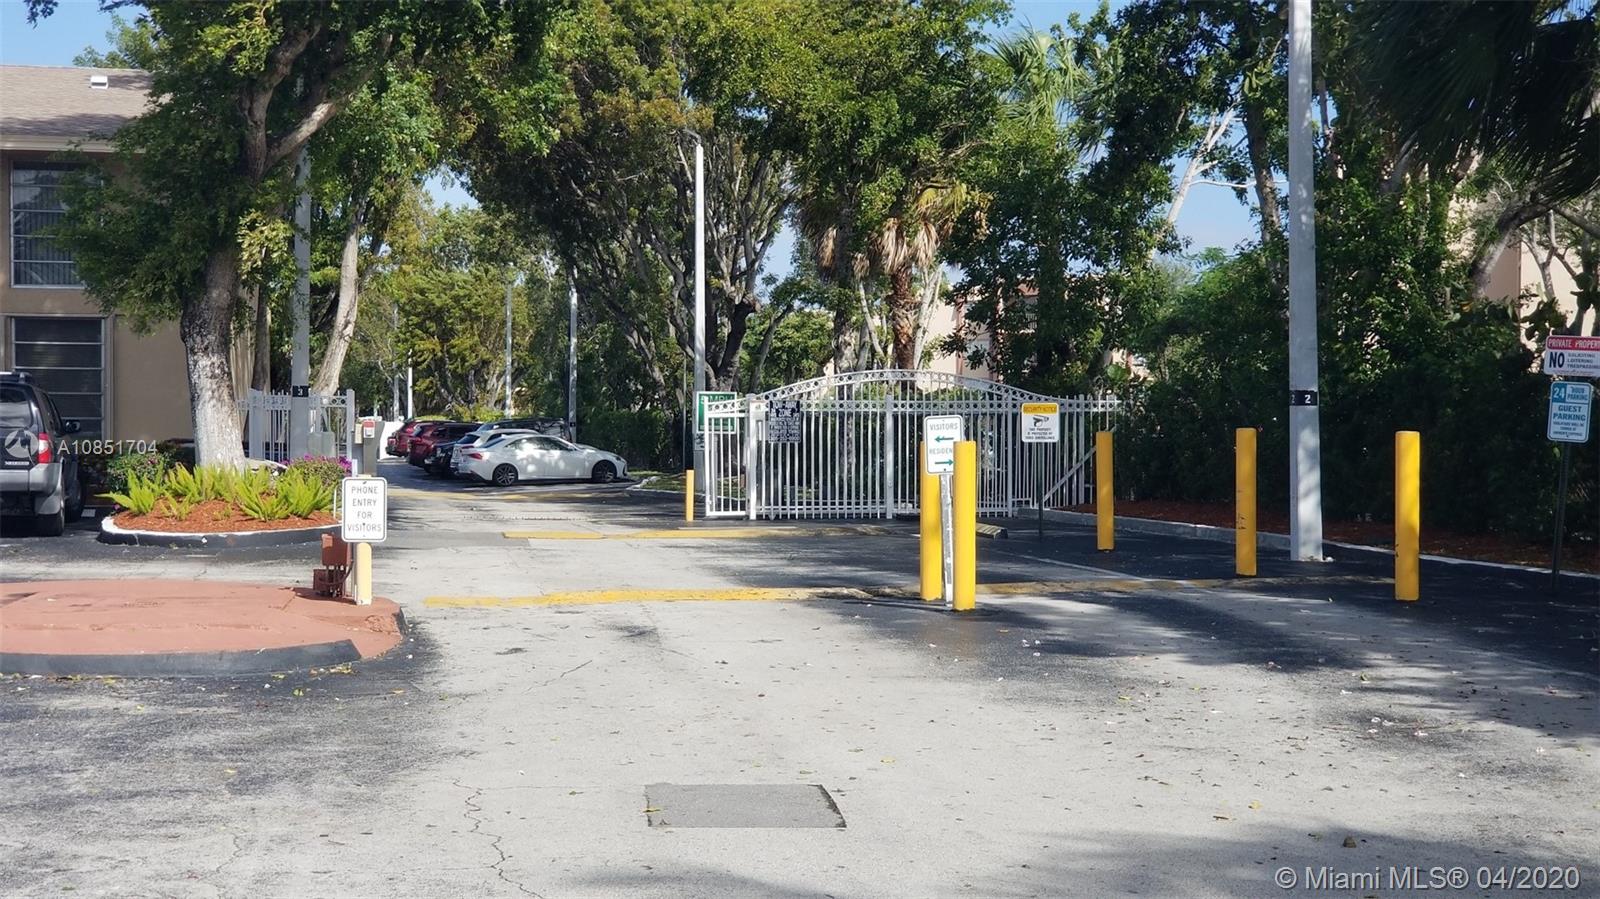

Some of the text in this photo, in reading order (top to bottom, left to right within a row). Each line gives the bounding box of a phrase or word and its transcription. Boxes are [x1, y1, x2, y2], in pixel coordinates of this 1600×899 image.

[1548, 338, 1572, 348] PRIVATE
[1548, 352, 1565, 368] NO
[1554, 388, 1565, 398] 24
[1304, 394, 1311, 404] 2
[1552, 412, 1586, 421] PARKING
[930, 422, 958, 430] VISITORS
[351, 486, 378, 494] PHONE
[352, 498, 377, 506] ENTRY
[356, 511, 373, 519] FOR
[347, 523, 382, 532] VISITORS
